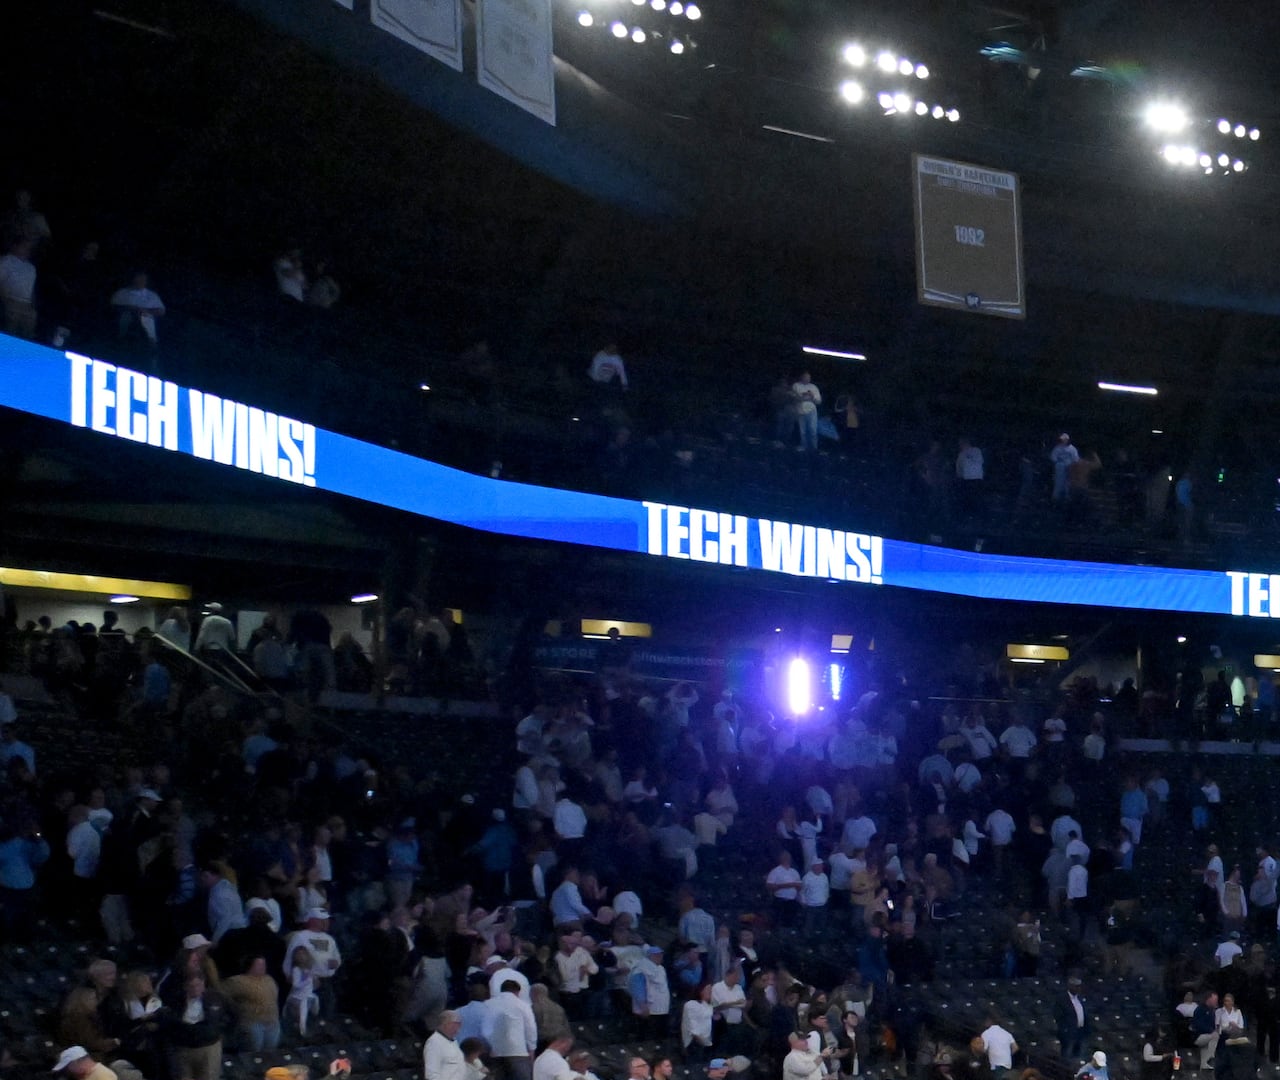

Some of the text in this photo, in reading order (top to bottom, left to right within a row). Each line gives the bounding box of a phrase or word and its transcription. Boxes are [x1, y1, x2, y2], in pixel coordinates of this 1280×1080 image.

[65, 351, 316, 487] TECH WINS!
[642, 501, 883, 585] TECH WINS!
